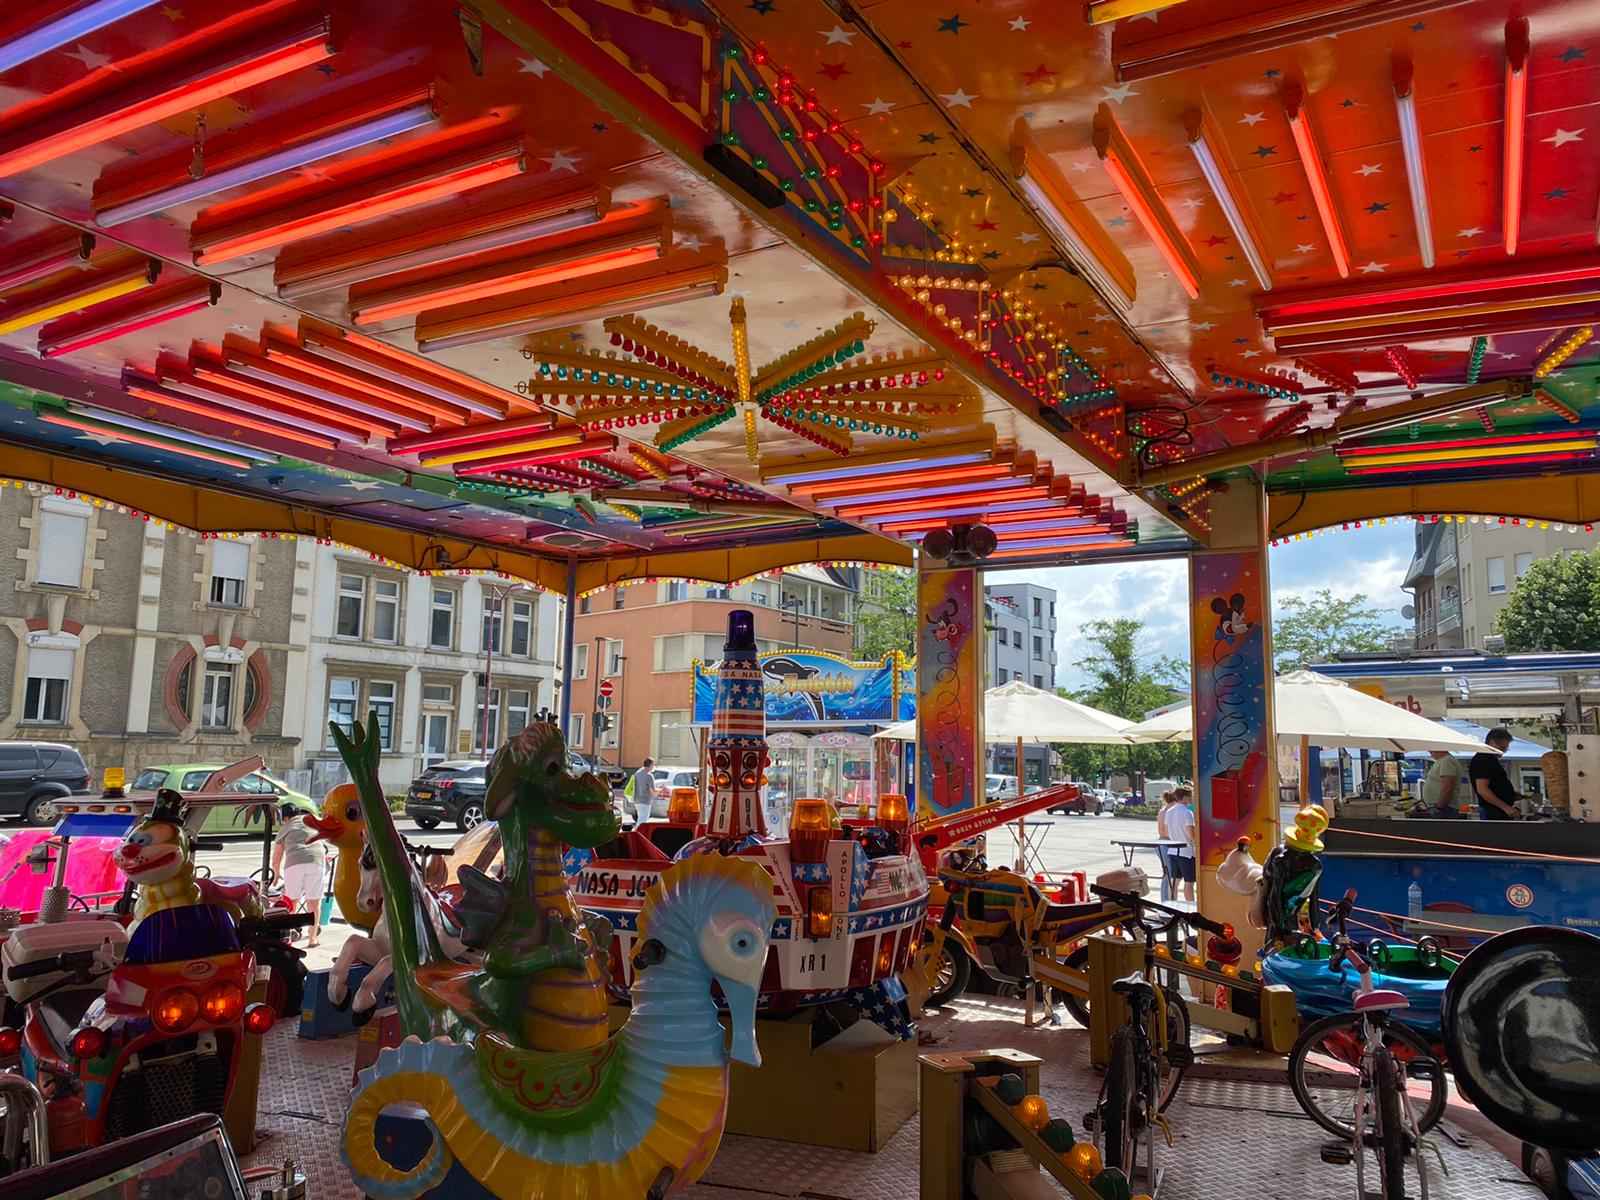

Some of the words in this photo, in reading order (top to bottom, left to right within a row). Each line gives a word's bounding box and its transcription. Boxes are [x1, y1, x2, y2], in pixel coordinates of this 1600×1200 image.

[575, 871, 619, 896] NASA
[839, 851, 848, 898] APOLLO
[835, 917, 844, 941] ONE
